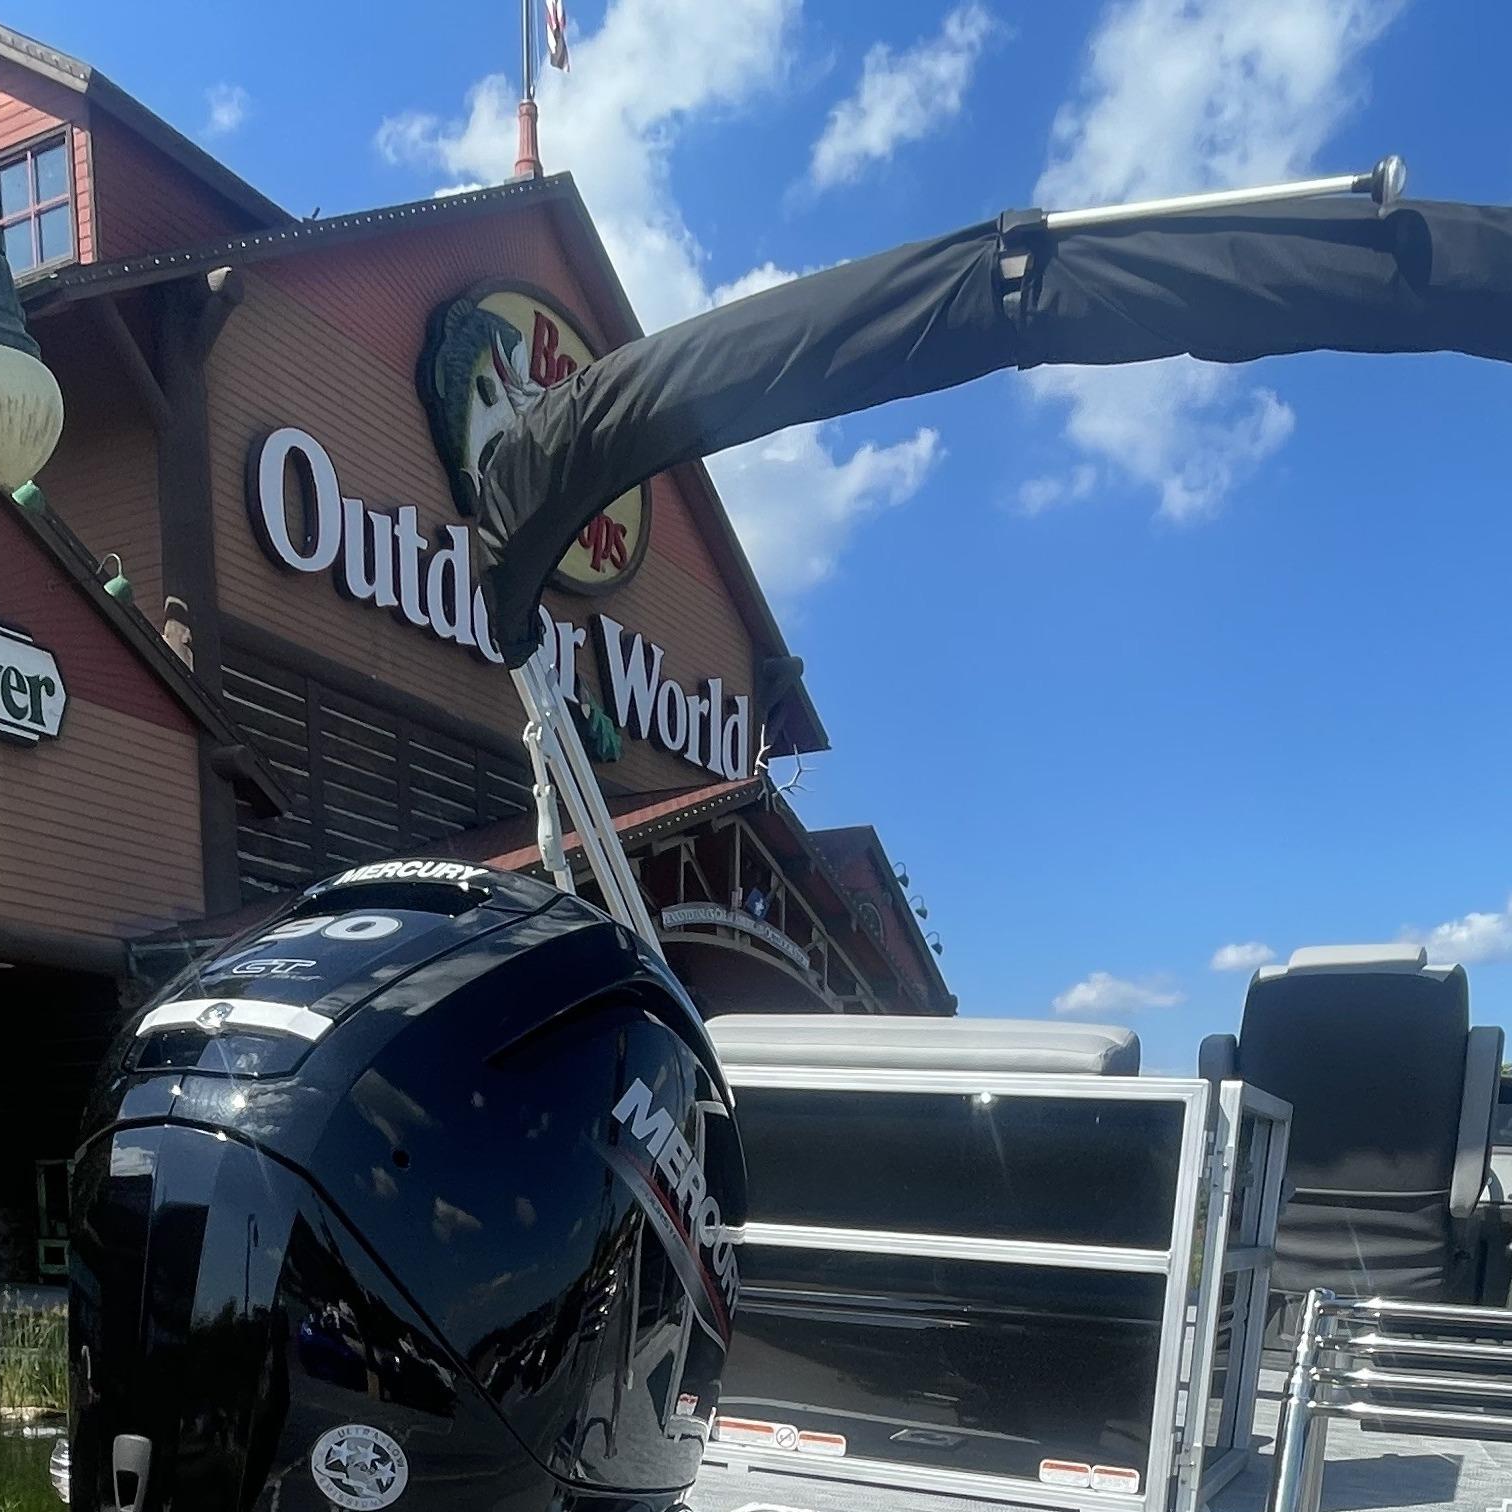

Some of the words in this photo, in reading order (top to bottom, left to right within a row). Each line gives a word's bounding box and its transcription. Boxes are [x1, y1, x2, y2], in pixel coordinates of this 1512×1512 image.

[529, 310, 578, 388] Ba
[578, 513, 627, 572] ops
[599, 614, 709, 780] World
[333, 861, 488, 886] MERCURY
[611, 1077, 740, 1320] MERCUR
